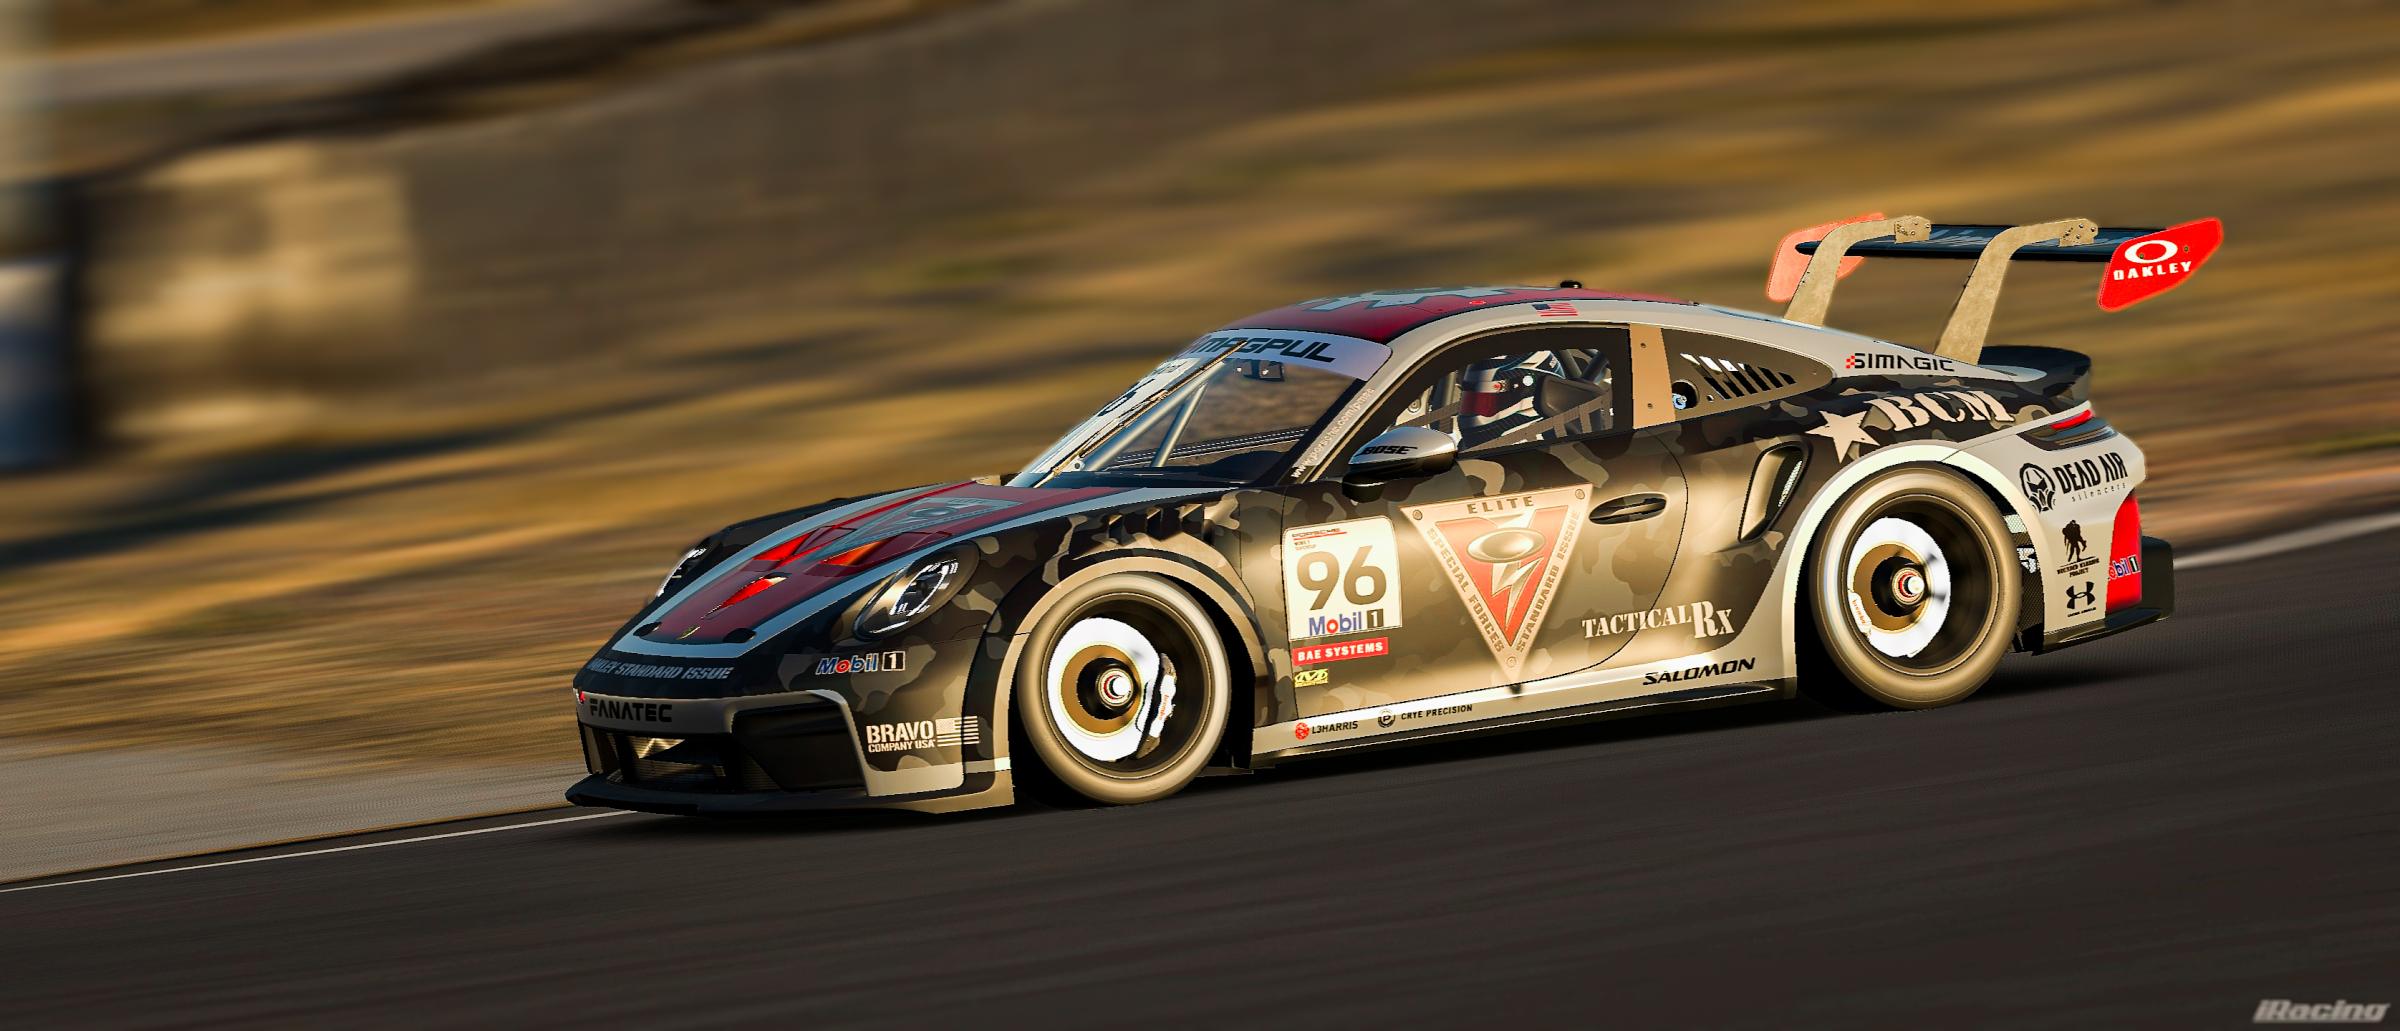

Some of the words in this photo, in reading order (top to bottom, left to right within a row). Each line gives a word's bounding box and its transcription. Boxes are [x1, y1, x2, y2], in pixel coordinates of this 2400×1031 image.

[2113, 260, 2192, 281] OAKLEY
[1188, 337, 1336, 363] MAGPUL
[1854, 352, 1955, 372] SIMAGIC
[1864, 390, 2016, 431] BCM
[1355, 445, 1418, 457] BOSE
[2052, 458, 2101, 494] DEAD
[2098, 452, 2128, 483] AIR
[1466, 495, 1535, 514] ELITE
[1296, 545, 1387, 611] 96
[2107, 558, 2132, 580] obil
[1426, 527, 1470, 593] SPECIAL
[1468, 594, 1505, 652] FORCES
[1516, 565, 1560, 652] STANDARD
[1557, 511, 1581, 560] ISSUE
[1308, 611, 1362, 636] Mobil
[1297, 649, 1321, 662] BAE
[1324, 641, 1384, 658] SYSTEMS
[614, 662, 682, 679] STANDARD
[681, 666, 735, 680] ISSUE
[815, 652, 878, 675] Mobil
[1642, 657, 1756, 686] SALOMON
[589, 698, 673, 723] FANATEC
[1401, 710, 1423, 720] CRYE
[1425, 703, 1473, 717] PRECISION
[865, 719, 935, 745] BRAVO
[1311, 720, 1359, 735] L3HARRIS
[868, 741, 913, 753] COMPANY
[914, 739, 935, 750] USA
